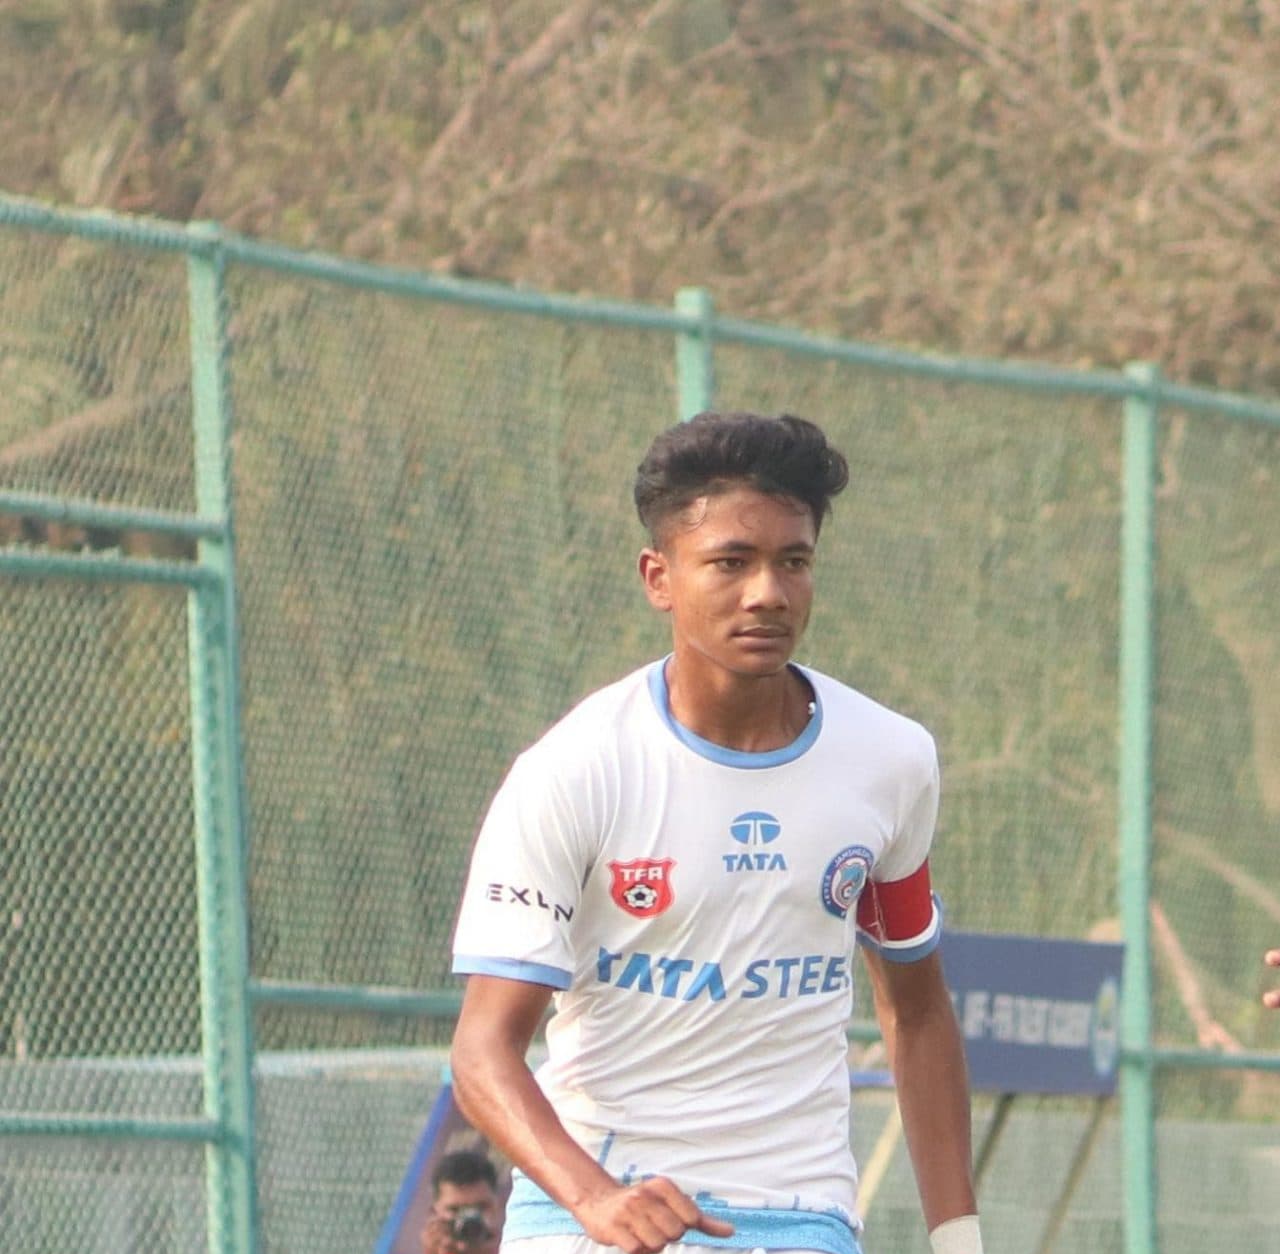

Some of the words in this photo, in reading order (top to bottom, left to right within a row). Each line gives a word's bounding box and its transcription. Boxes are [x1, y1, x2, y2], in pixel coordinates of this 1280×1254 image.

[723, 853, 787, 873] TATA
[619, 867, 664, 882] TFA
[596, 946, 727, 1002] TATA
[740, 955, 850, 999] STEE
